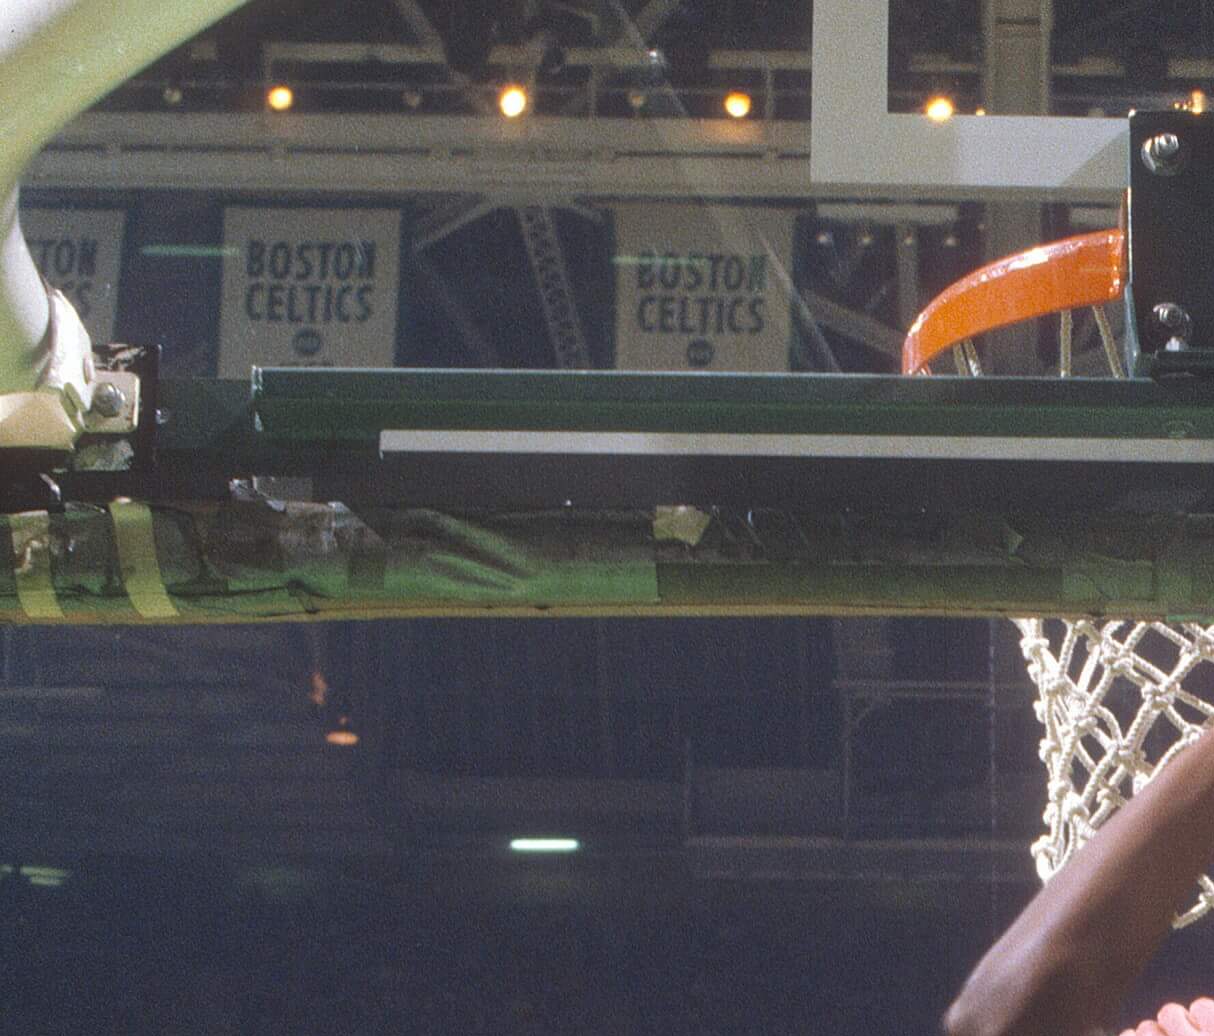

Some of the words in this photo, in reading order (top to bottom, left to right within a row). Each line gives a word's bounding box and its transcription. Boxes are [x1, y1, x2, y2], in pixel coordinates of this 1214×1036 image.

[246, 239, 376, 279] BOSTON
[637, 251, 769, 291] BOSTON
[245, 284, 373, 323] CELTICS
[637, 296, 766, 334] CELTICS
